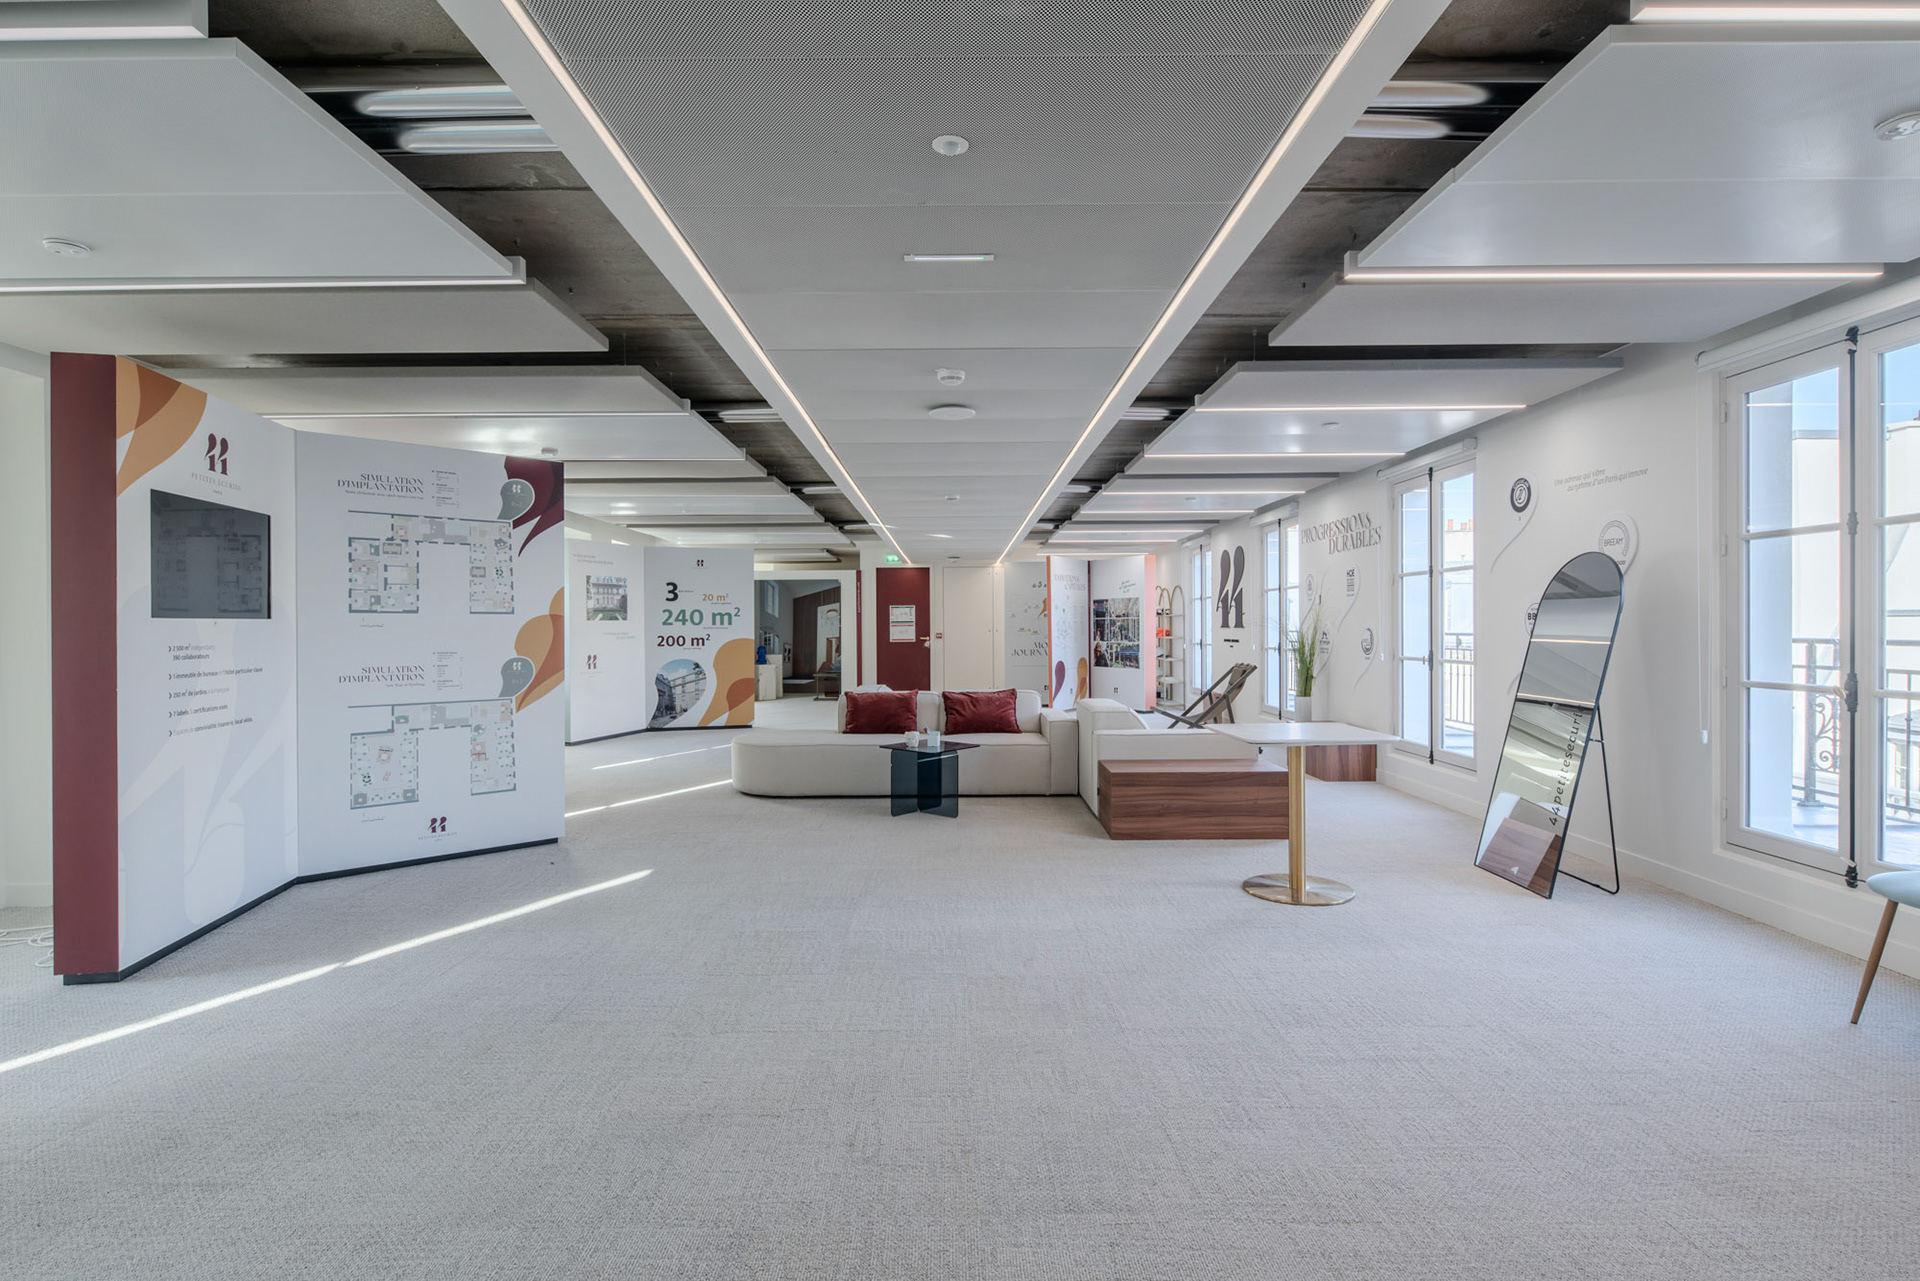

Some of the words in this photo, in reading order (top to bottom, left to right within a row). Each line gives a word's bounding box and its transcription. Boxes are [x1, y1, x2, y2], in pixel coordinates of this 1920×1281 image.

[360, 473, 424, 486] SIMULATION
[337, 480, 424, 494] D'IMPLANTATION
[1301, 511, 1372, 545] PROGRESSIONS
[1329, 526, 1382, 555] DURABLES
[665, 581, 679, 602] 3
[702, 593, 714, 602] 20
[716, 593, 729, 602] m²
[661, 608, 704, 626] 240
[711, 607, 741, 626] m²
[657, 635, 686, 647] 200
[691, 633, 711, 647] m²
[361, 665, 425, 674] SIMULATION
[338, 673, 425, 683] D'IMPLANTATION
